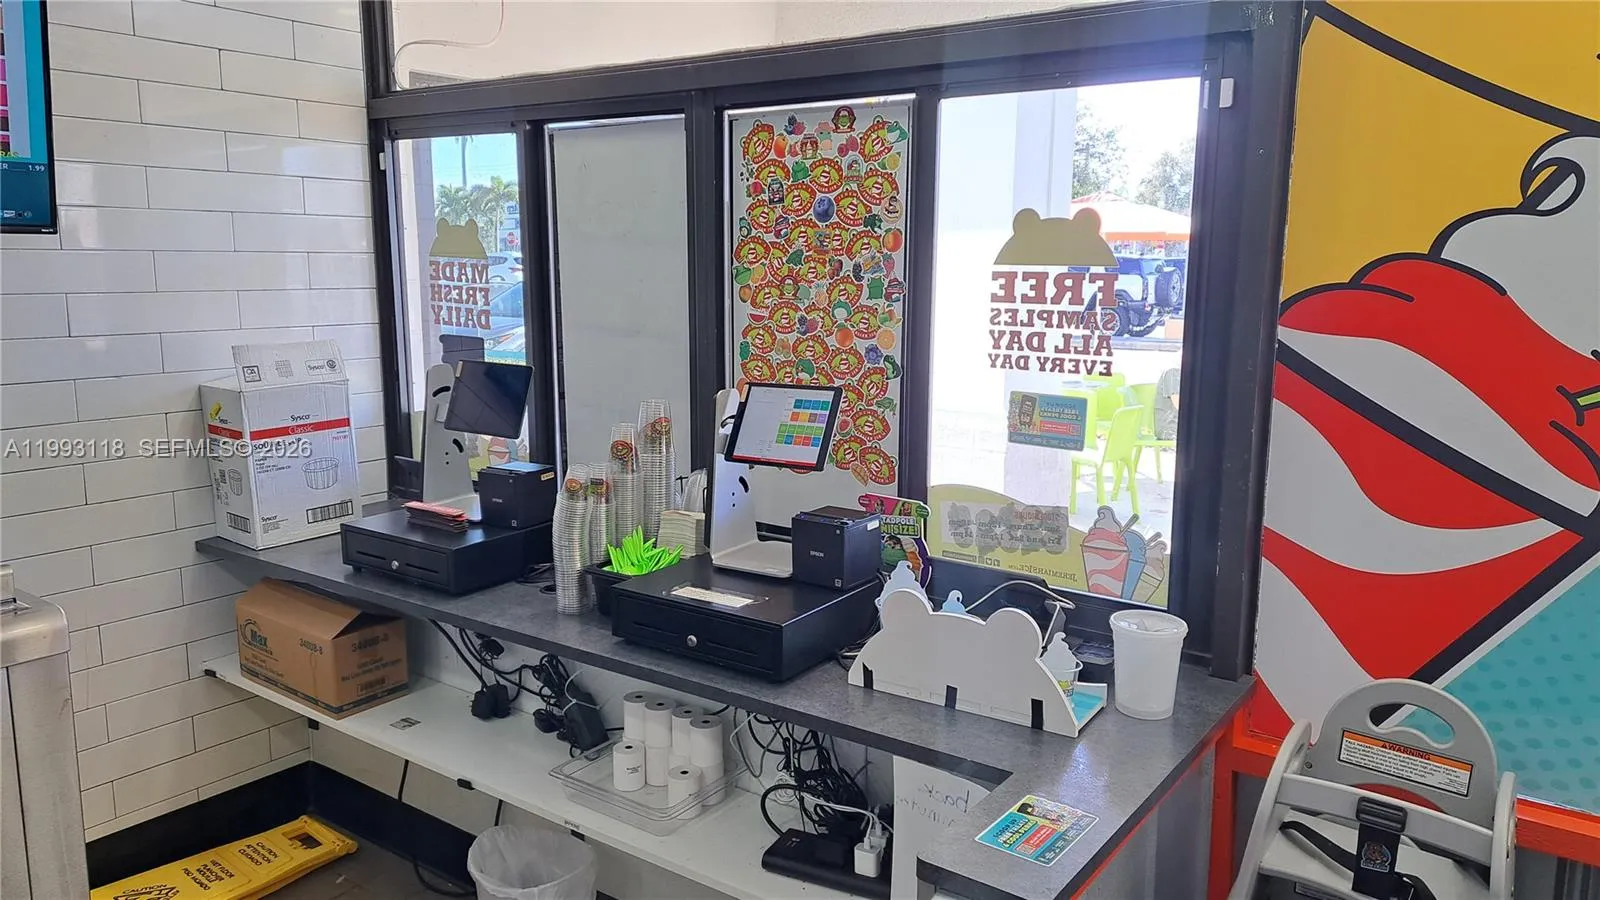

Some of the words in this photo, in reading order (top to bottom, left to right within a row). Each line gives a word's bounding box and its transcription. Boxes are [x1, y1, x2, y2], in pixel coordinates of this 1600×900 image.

[307, 364, 325, 372] Sysco
[288, 424, 315, 436] Classic
[260, 515, 278, 523] Sysco
[893, 525, 918, 535] SIZE!
[251, 629, 268, 648] Max
[1388, 743, 1431, 760] WARNING
[245, 844, 272, 864] ATTENTION
[256, 841, 279, 858] CAUTION
[238, 849, 263, 866] CUIDADO
[219, 864, 236, 879] FLOOR
[122, 884, 168, 894] CAUTION
